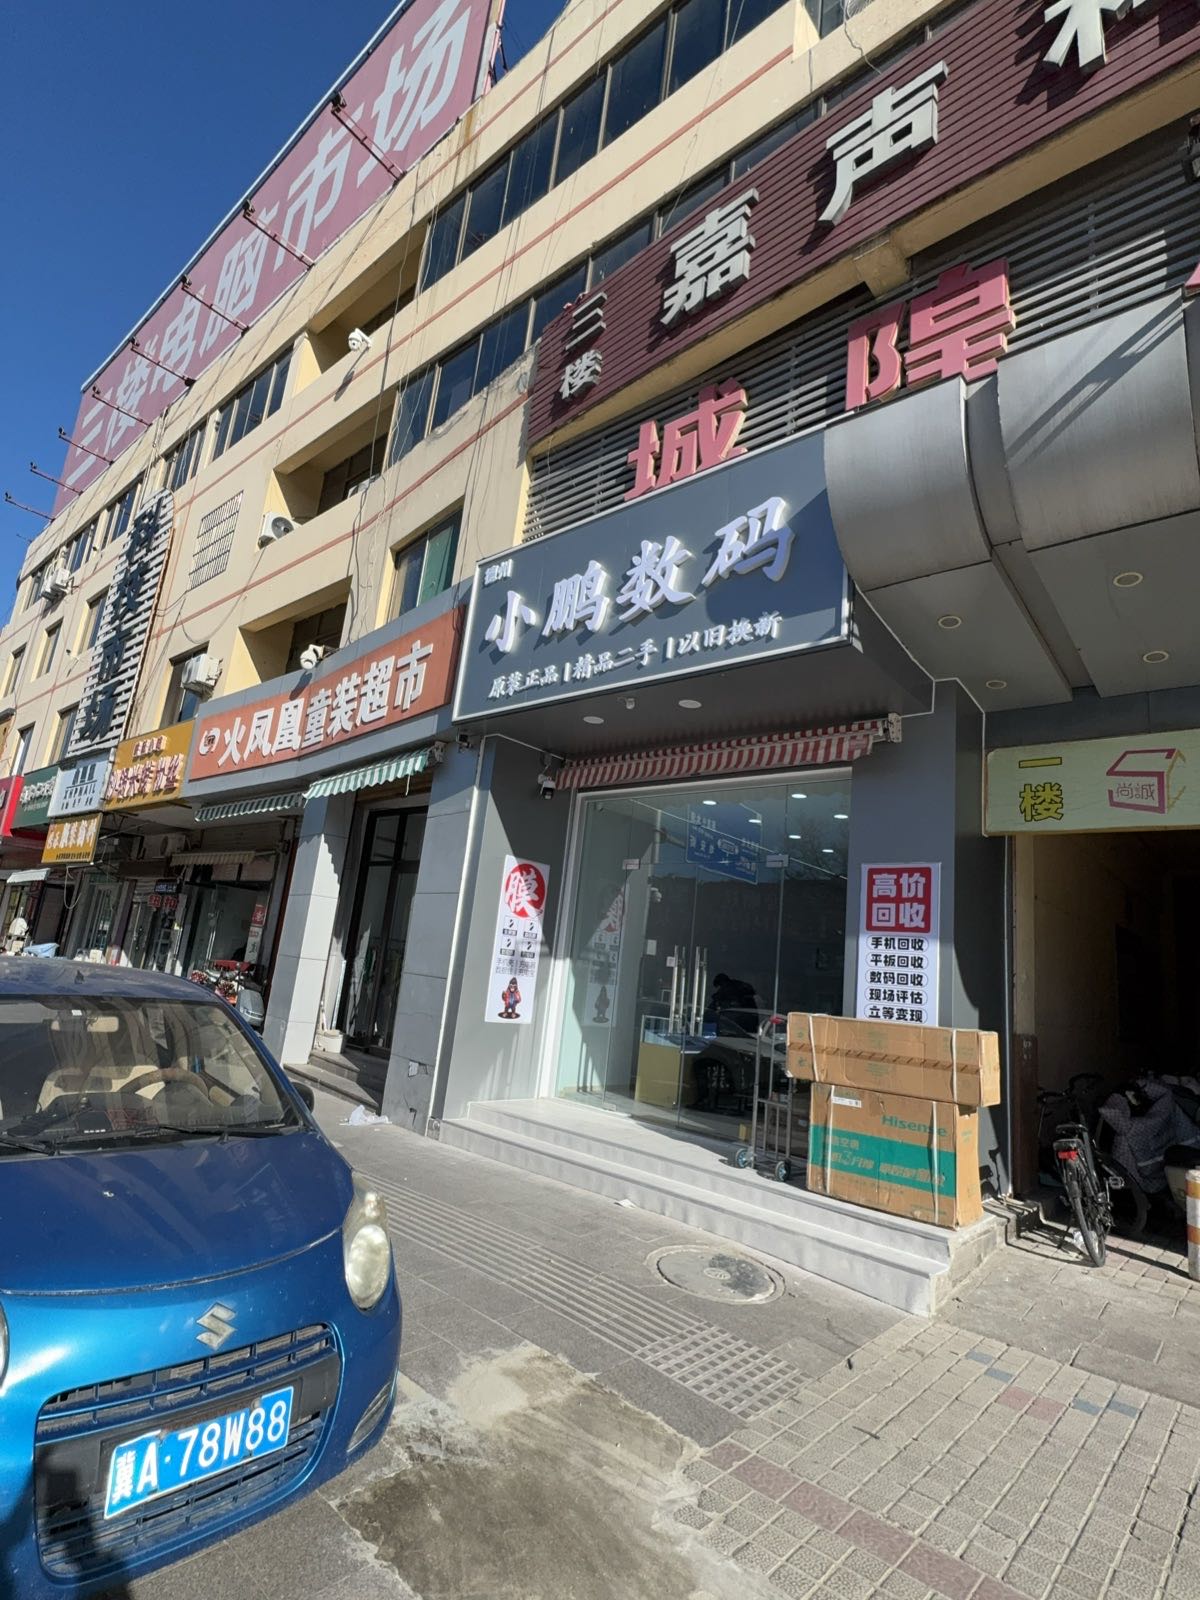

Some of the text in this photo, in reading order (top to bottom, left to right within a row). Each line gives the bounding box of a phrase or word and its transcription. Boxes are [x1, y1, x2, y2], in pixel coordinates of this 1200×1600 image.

[560, 292, 607, 399] 三楼
[624, 257, 1200, 500] 城隍
[484, 496, 796, 653] 小鹏数码
[217, 639, 434, 767] 火凤凰童装超市
[1018, 756, 1064, 823] 一楼
[505, 867, 541, 918] 膜
[872, 872, 926, 898] 高价
[871, 902, 926, 928] 回收
[871, 936, 924, 951] 手机回收
[870, 954, 924, 969] 平板回收
[869, 971, 924, 986] 数码回收
[868, 988, 923, 1004] 现场评估
[868, 1005, 923, 1023] 立等变现
